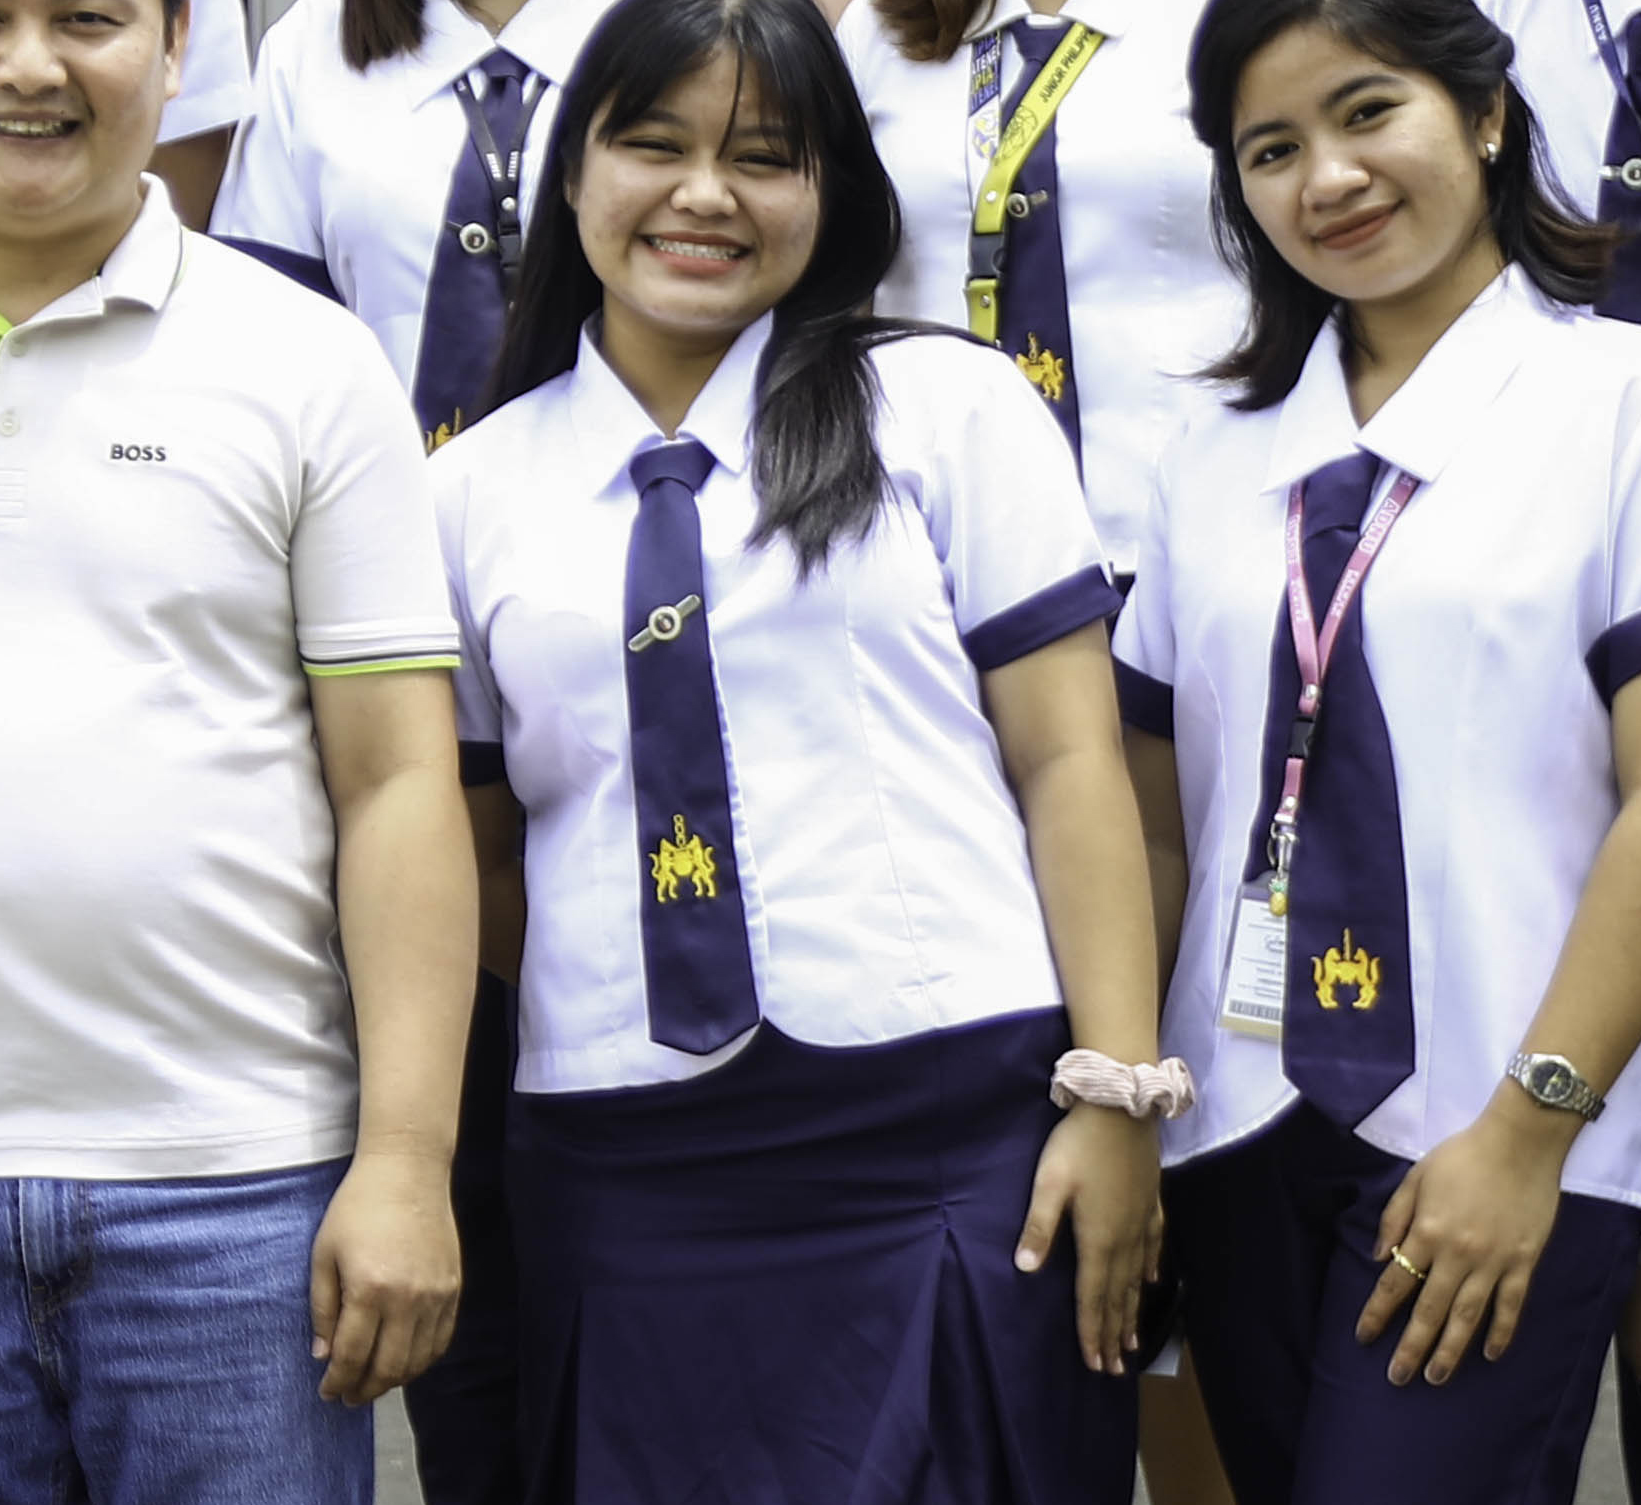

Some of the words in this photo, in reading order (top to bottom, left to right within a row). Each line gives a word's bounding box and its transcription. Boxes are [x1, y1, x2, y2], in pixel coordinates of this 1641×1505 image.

[1038, 65, 1068, 104] JUNIOR
[110, 443, 167, 462] BOSS
[1358, 497, 1401, 556] ADNU
